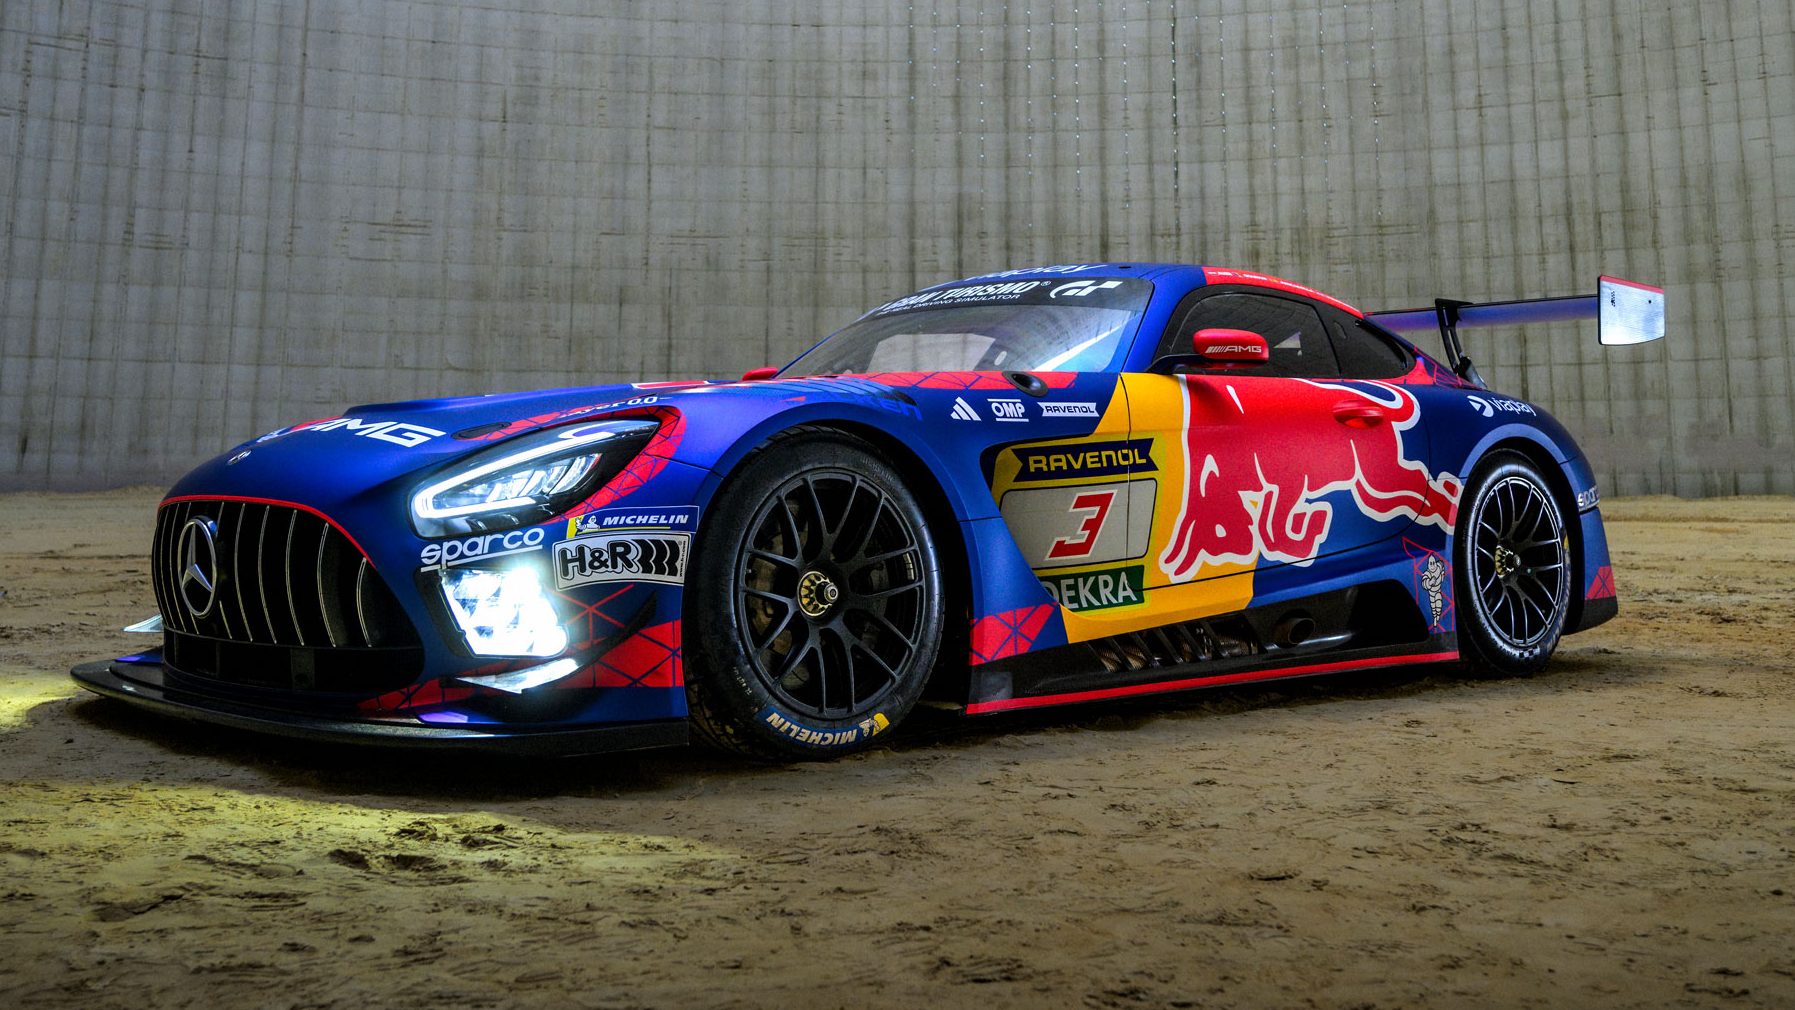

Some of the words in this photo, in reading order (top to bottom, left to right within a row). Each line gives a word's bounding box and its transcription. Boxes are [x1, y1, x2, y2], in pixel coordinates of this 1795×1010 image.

[954, 294, 1020, 303] SIMULATOR
[1224, 345, 1262, 353] AMG
[991, 402, 1025, 418] OMP
[1046, 405, 1095, 414] RAVENOL
[1028, 447, 1147, 473] RAVENOL
[602, 514, 689, 526] MICHELIN
[1043, 489, 1118, 562] 3
[420, 526, 545, 568] sparco
[558, 538, 637, 580] H&R
[766, 711, 858, 747] MICHELIN
